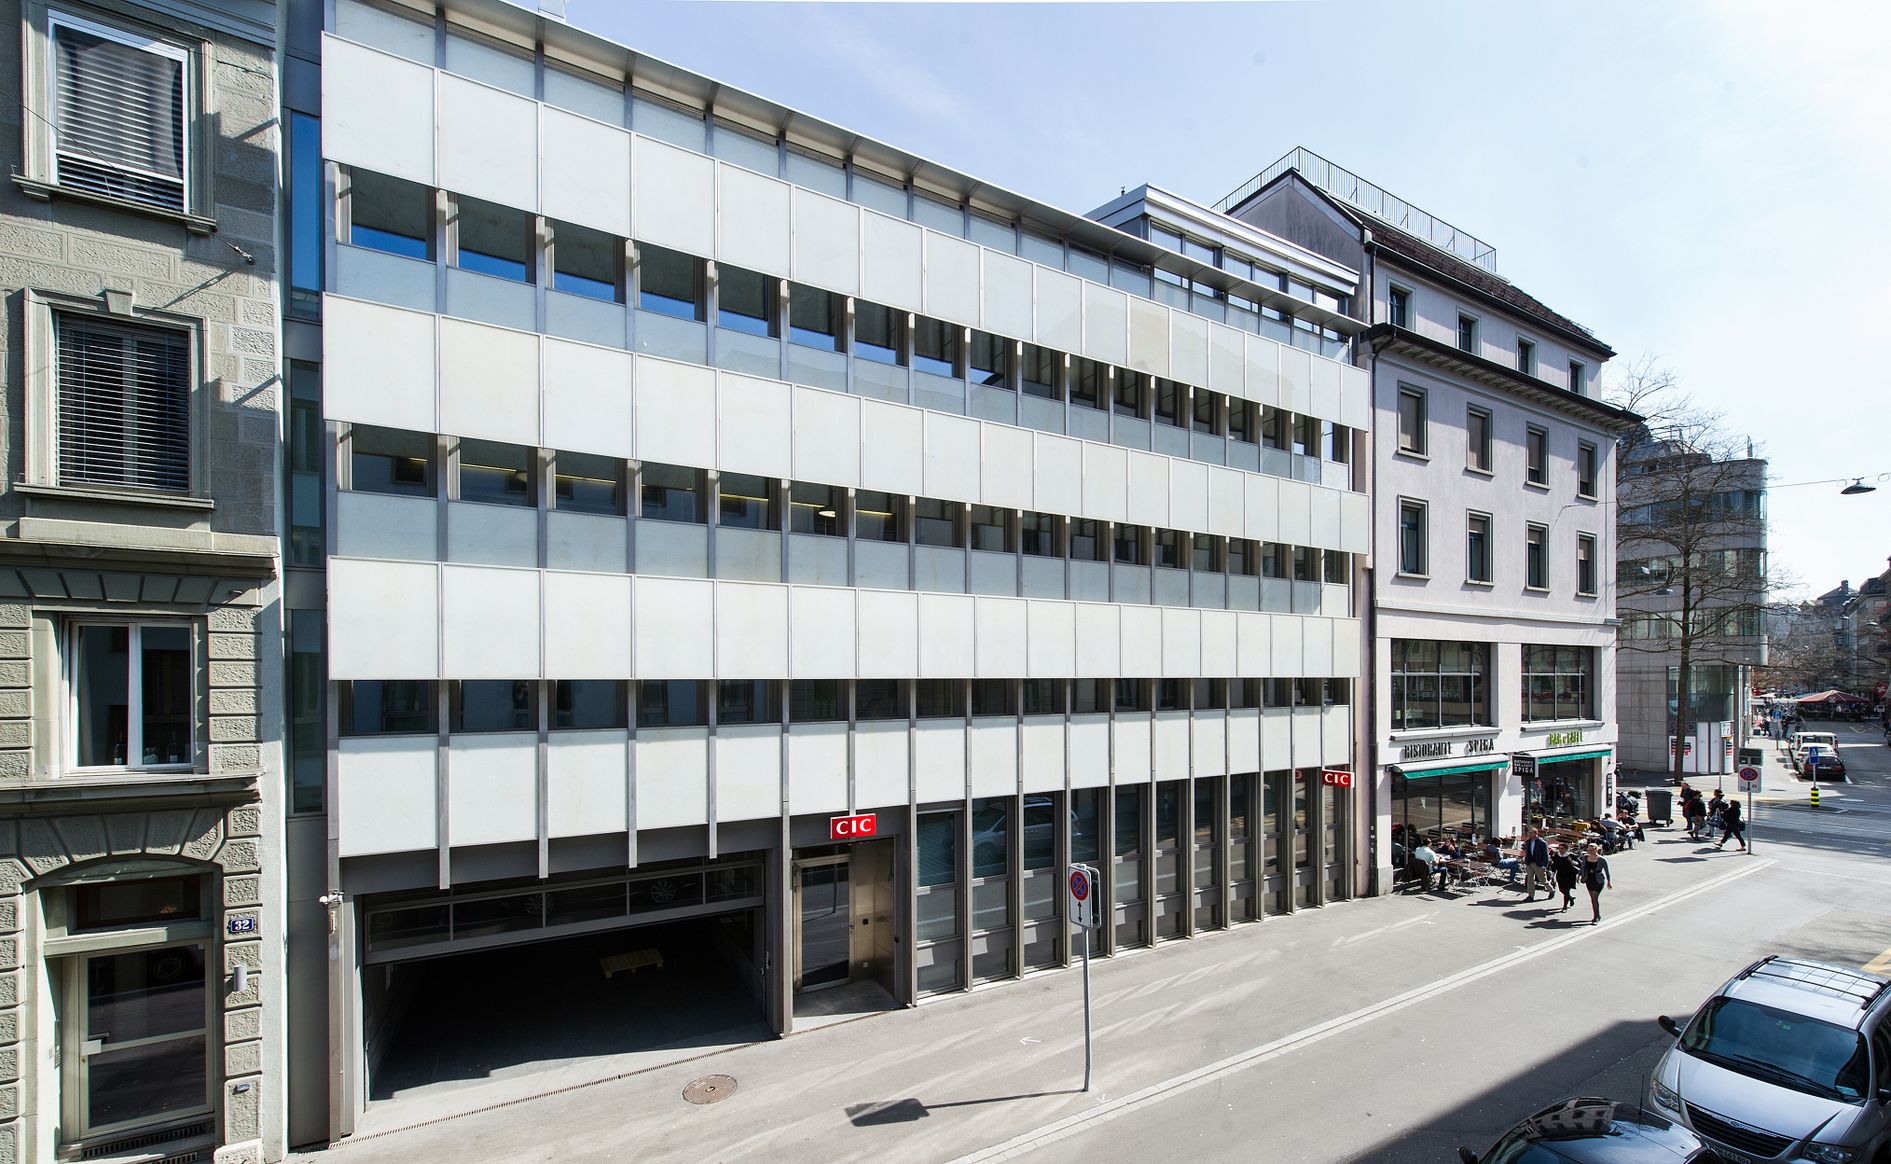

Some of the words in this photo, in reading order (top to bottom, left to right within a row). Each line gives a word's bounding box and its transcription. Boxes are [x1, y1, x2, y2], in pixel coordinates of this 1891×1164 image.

[1404, 741, 1453, 759] RISTORANTE
[1468, 738, 1494, 752] SPIGA
[1325, 773, 1349, 785] CIC
[836, 818, 872, 835] CIC
[234, 919, 250, 931] 32
